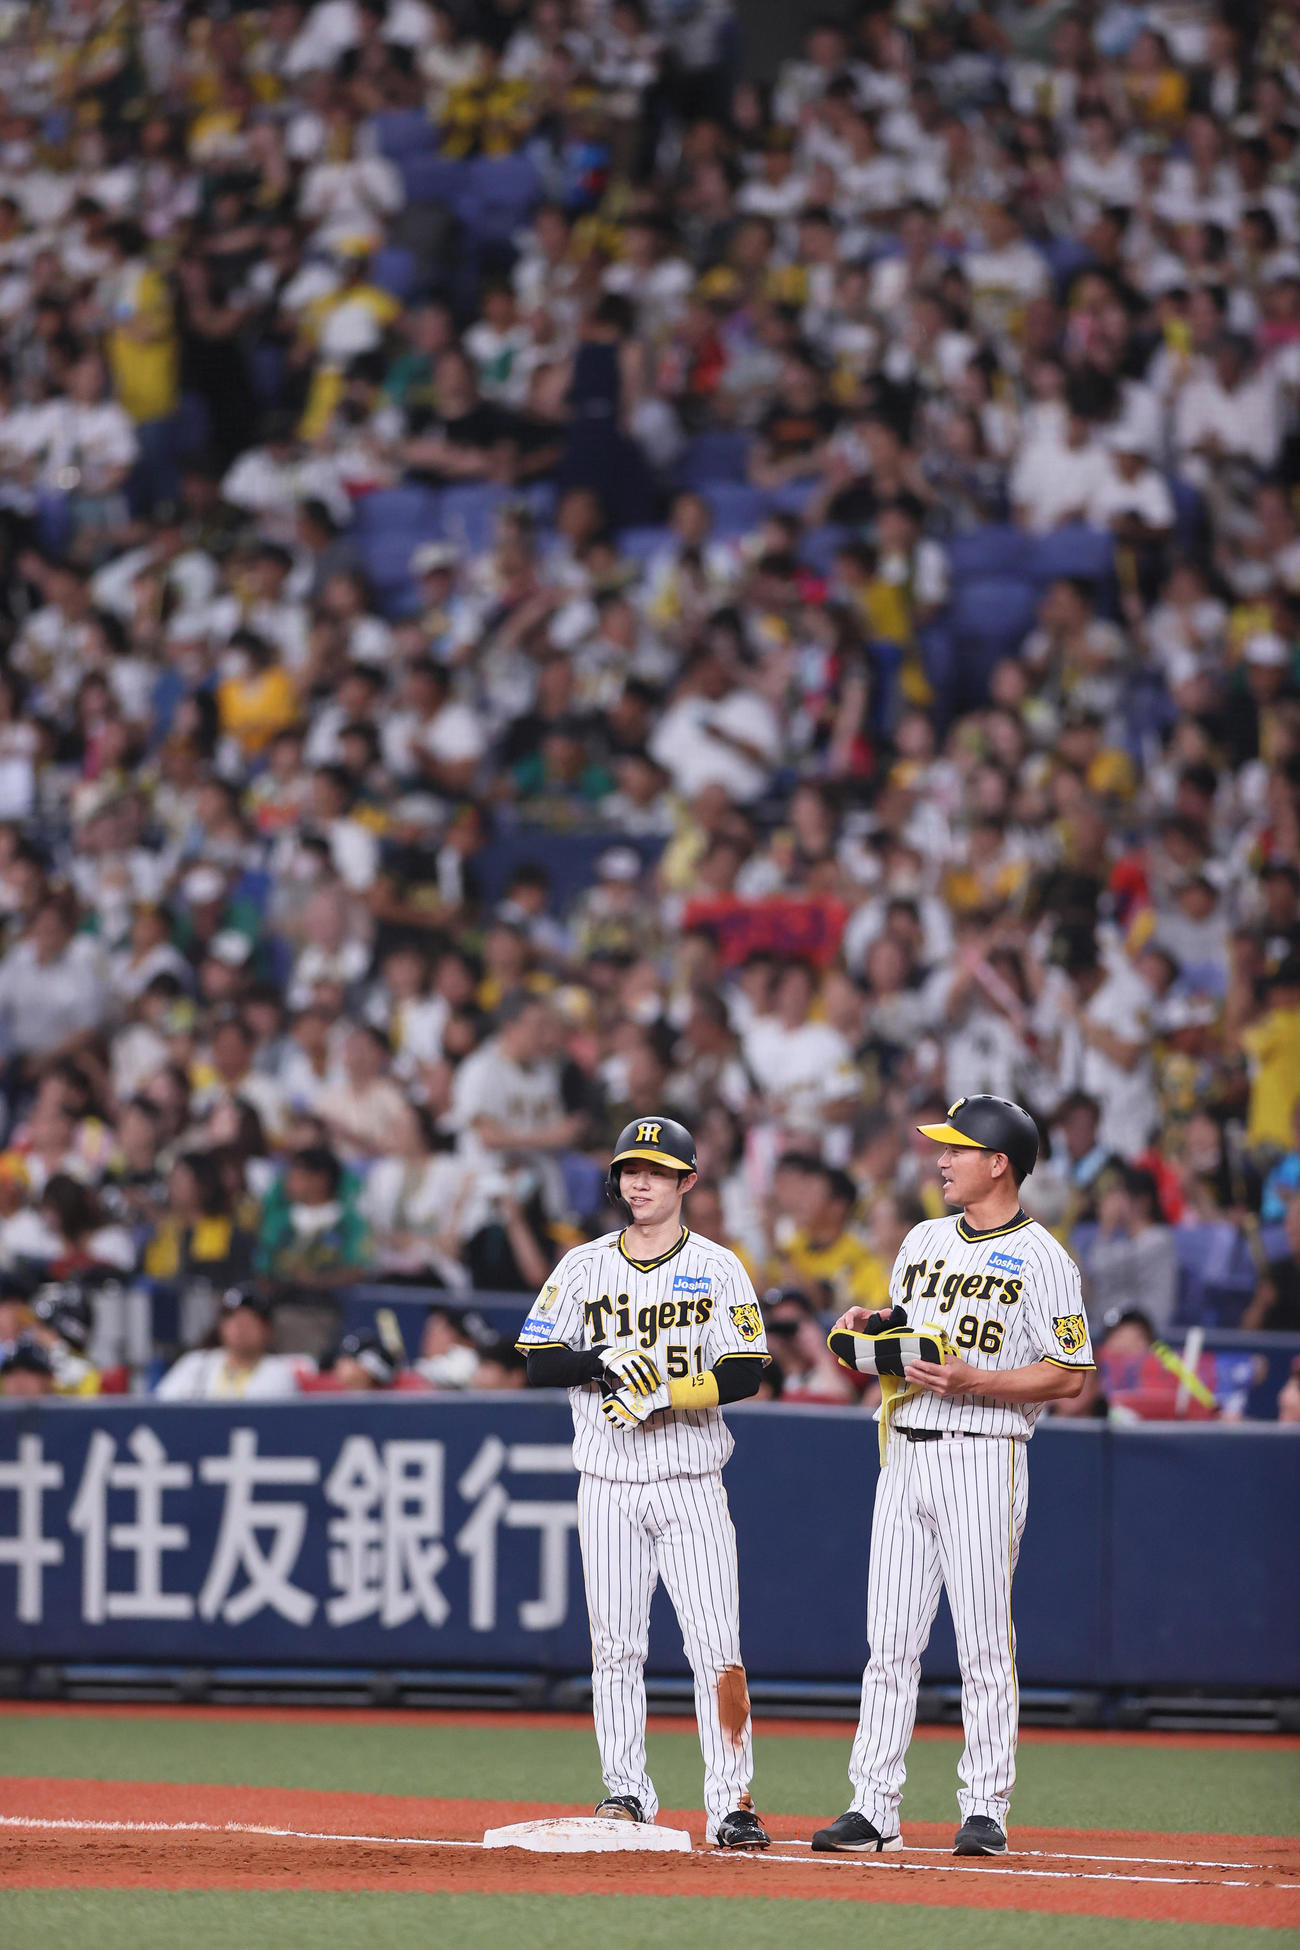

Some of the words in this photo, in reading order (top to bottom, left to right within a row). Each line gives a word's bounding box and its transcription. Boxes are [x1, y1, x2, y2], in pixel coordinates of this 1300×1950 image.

[991, 1255, 1021, 1272] Joshin
[902, 1259, 1023, 1313] Tigers
[584, 1293, 713, 1349] Tigers
[955, 1314, 1005, 1355] 96
[666, 1344, 703, 1379] 51
